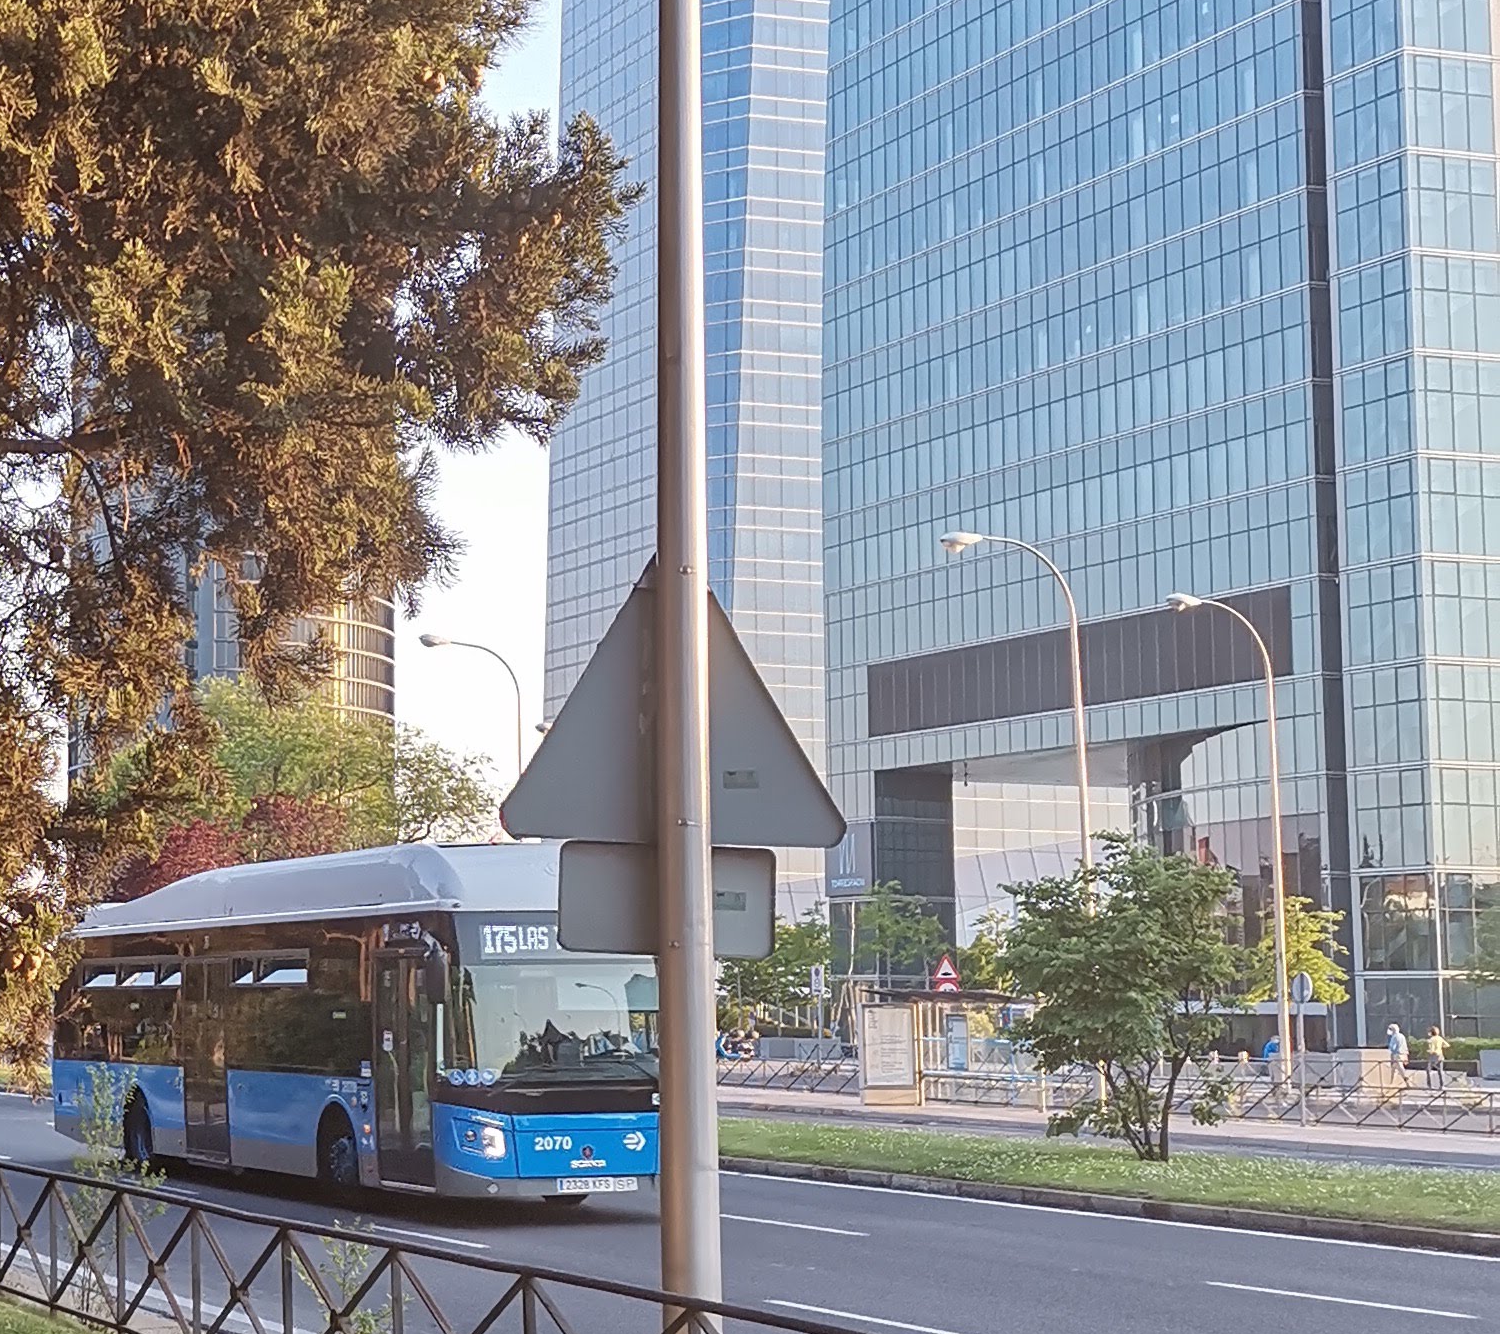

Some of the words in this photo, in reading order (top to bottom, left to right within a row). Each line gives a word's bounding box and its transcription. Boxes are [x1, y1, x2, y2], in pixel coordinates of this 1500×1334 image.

[483, 925, 517, 954] 175
[518, 925, 549, 950] LAS
[534, 1136, 572, 1151] 2070
